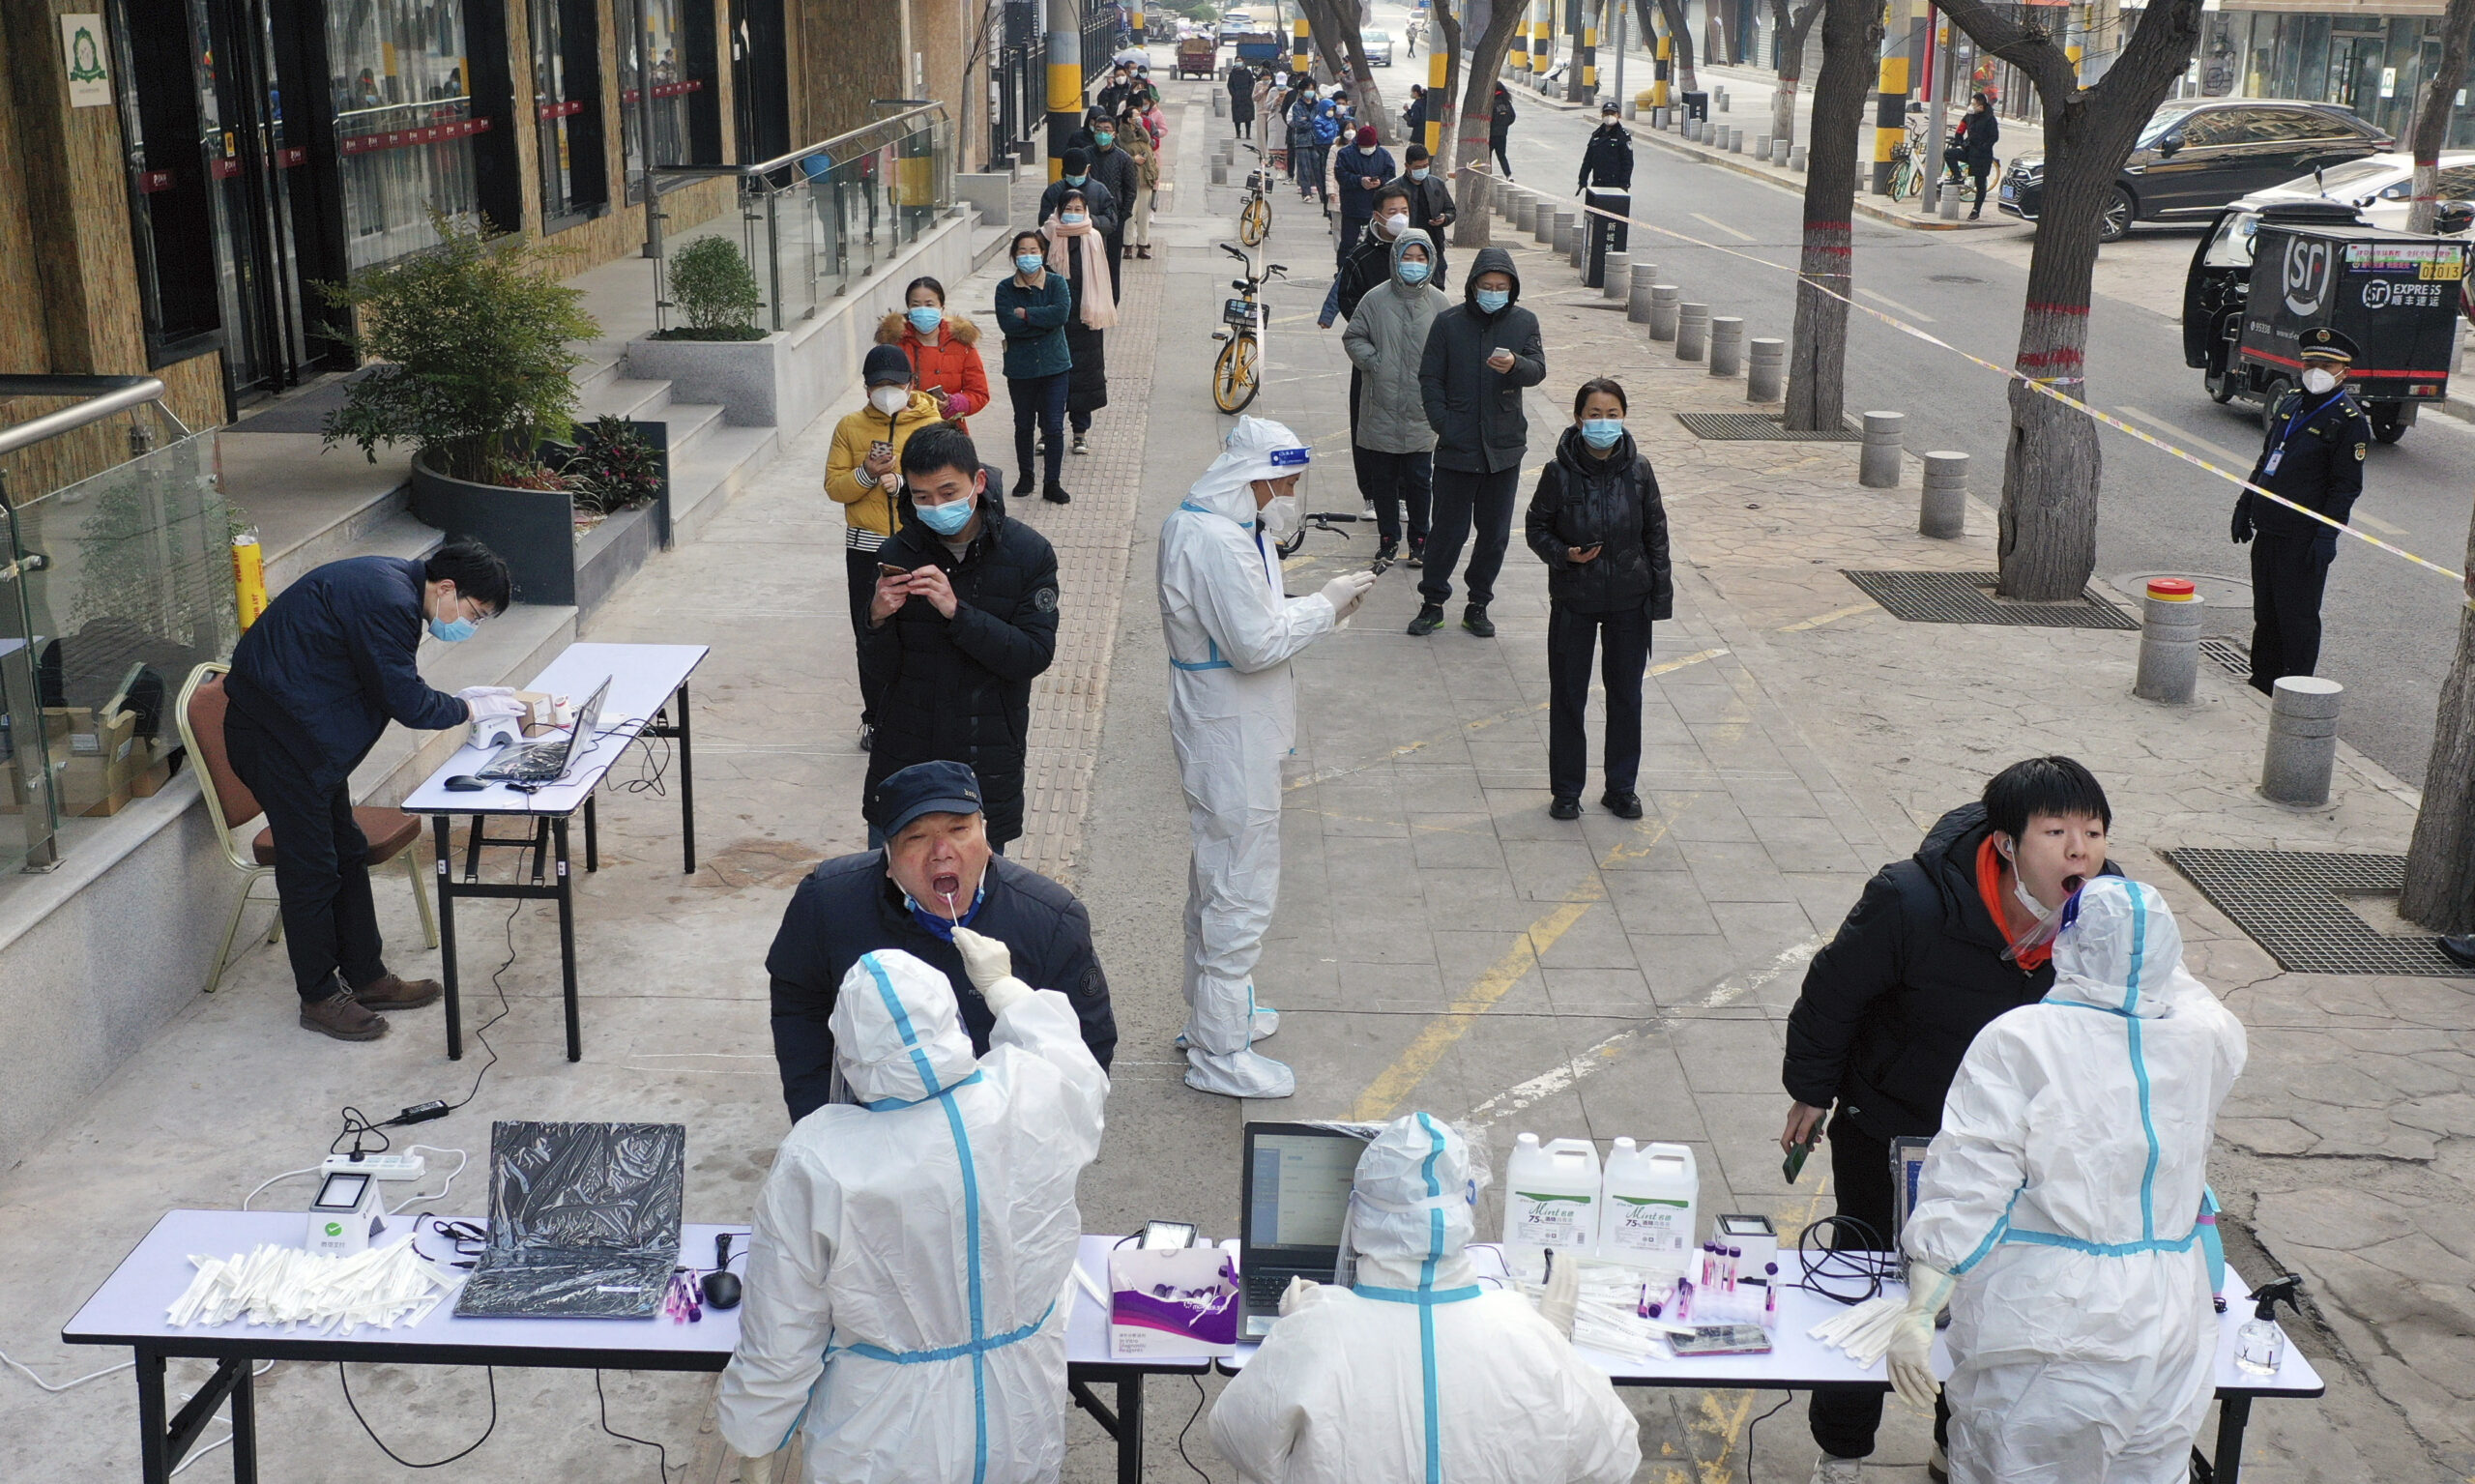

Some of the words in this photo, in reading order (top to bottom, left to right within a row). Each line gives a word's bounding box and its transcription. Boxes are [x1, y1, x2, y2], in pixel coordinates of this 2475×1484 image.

[2393, 283, 2442, 295] EXPRESS
[1529, 1203, 1560, 1215] Mint
[1625, 1207, 1657, 1219] Mint
